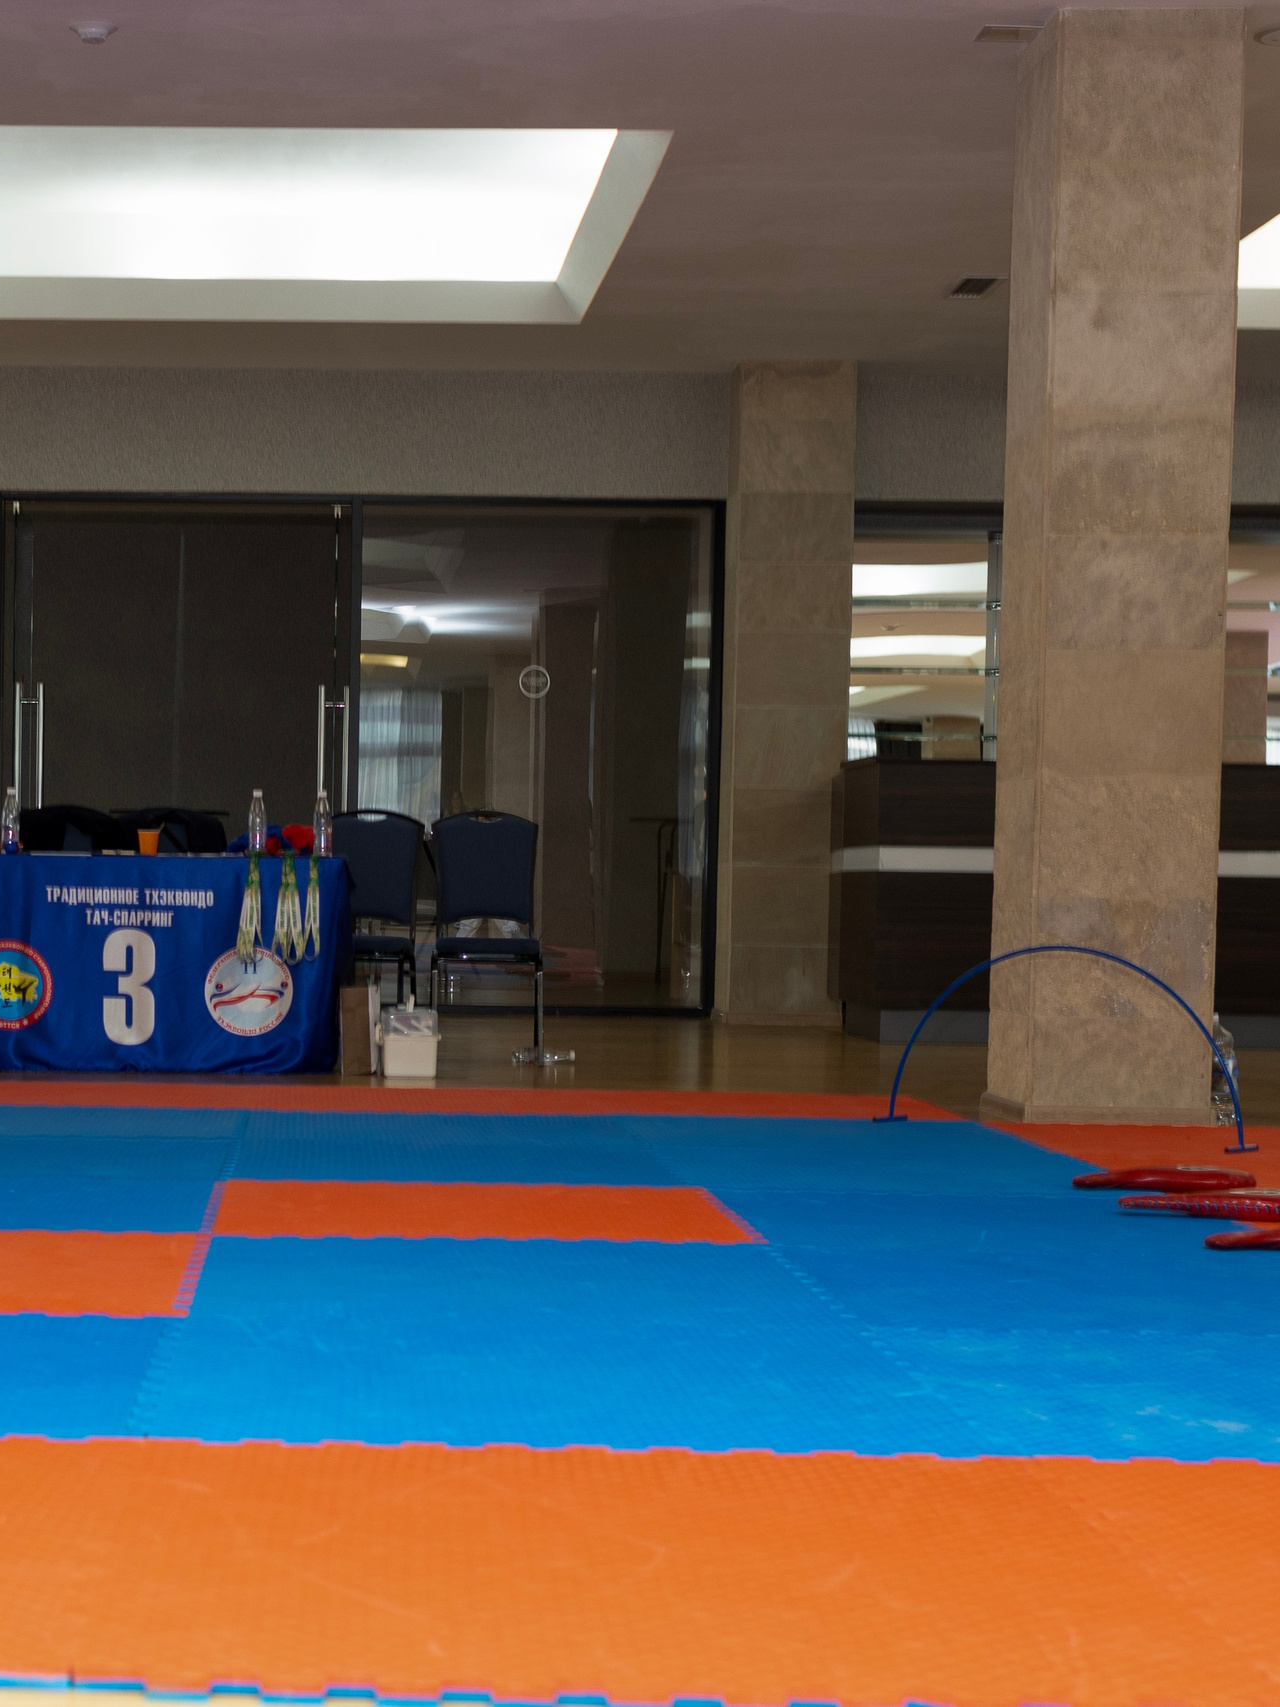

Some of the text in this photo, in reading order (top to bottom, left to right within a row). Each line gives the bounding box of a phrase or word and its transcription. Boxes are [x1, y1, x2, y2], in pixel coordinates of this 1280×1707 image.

[45, 885, 214, 909] ТРАДИЦИОННОЕ ТХЭКВОНДО
[85, 908, 174, 927] ТАЧ-СПАРРИНГ
[208, 950, 238, 984] ФЕДЕРАЦИЯ
[102, 928, 156, 1046] 3
[218, 1011, 283, 1035] ТХЭКВОНДО РОССИИ
